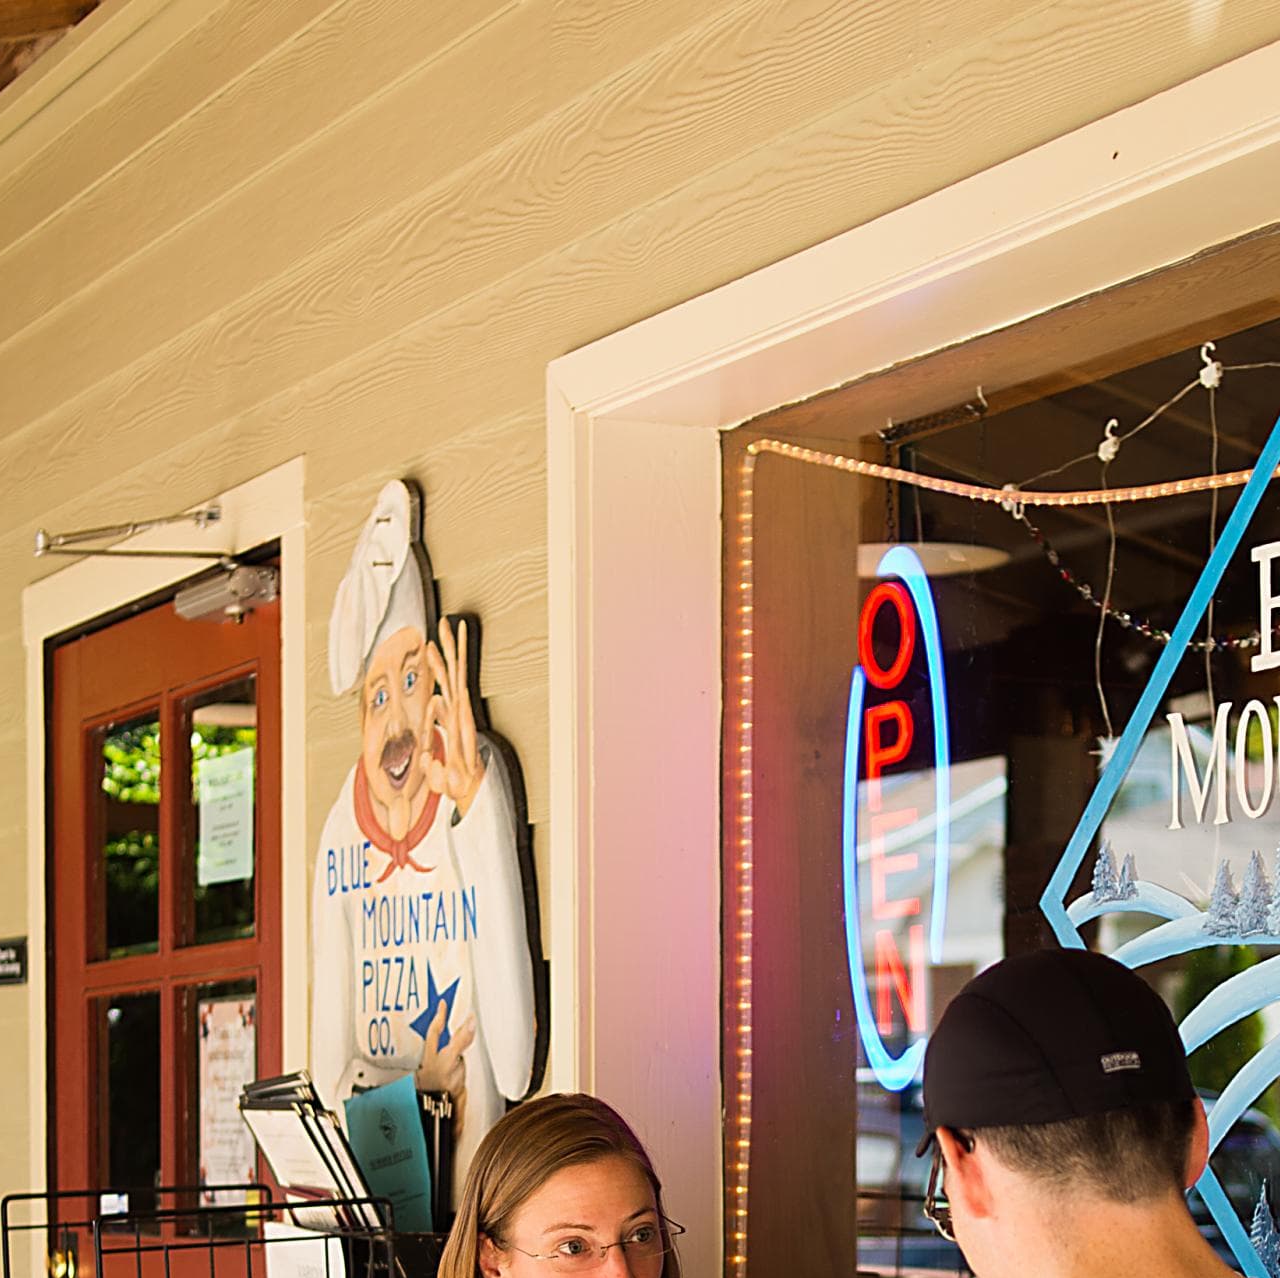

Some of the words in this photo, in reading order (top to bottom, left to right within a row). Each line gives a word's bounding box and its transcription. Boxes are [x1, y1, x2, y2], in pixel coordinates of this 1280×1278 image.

[857, 581, 926, 1036] OPEN
[327, 841, 371, 896] BLUE
[362, 885, 478, 949] MOUNTAIN
[362, 956, 420, 1013] PIZZA
[368, 1016, 395, 1056] CO.
